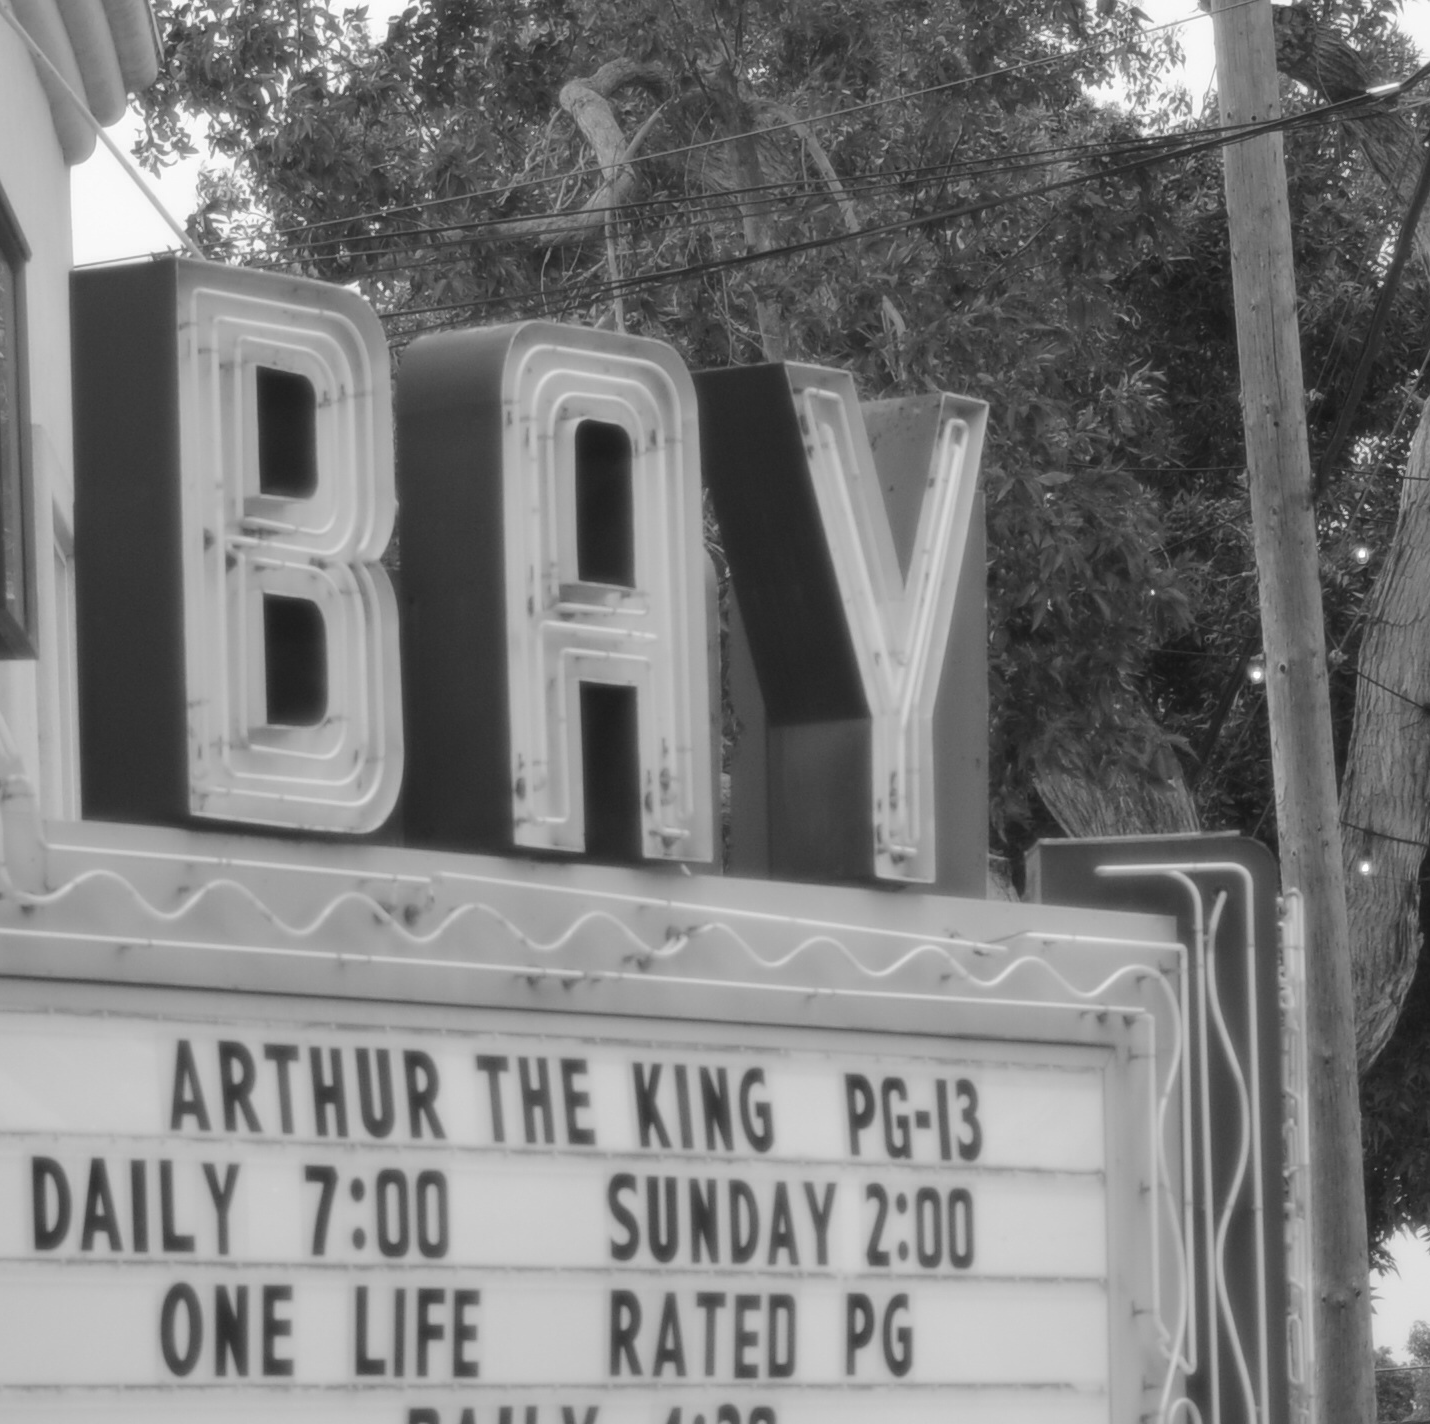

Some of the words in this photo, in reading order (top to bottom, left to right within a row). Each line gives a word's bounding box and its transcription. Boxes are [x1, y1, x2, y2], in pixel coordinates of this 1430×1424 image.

[171, 257, 991, 890] BAY
[168, 1038, 448, 1140] ARTHUR
[475, 1053, 597, 1147] THE
[631, 1061, 775, 1154] KING
[842, 1072, 984, 1163] PG-13
[31, 1156, 241, 1256] DAILY
[303, 1165, 449, 1260] 7:00
[607, 1172, 838, 1267] SUNDAY
[863, 1183, 975, 1270] 2:00
[159, 1284, 295, 1378] ONE
[353, 1285, 482, 1379] LIFE
[608, 1288, 797, 1380] RATED
[844, 1292, 915, 1378] PG
